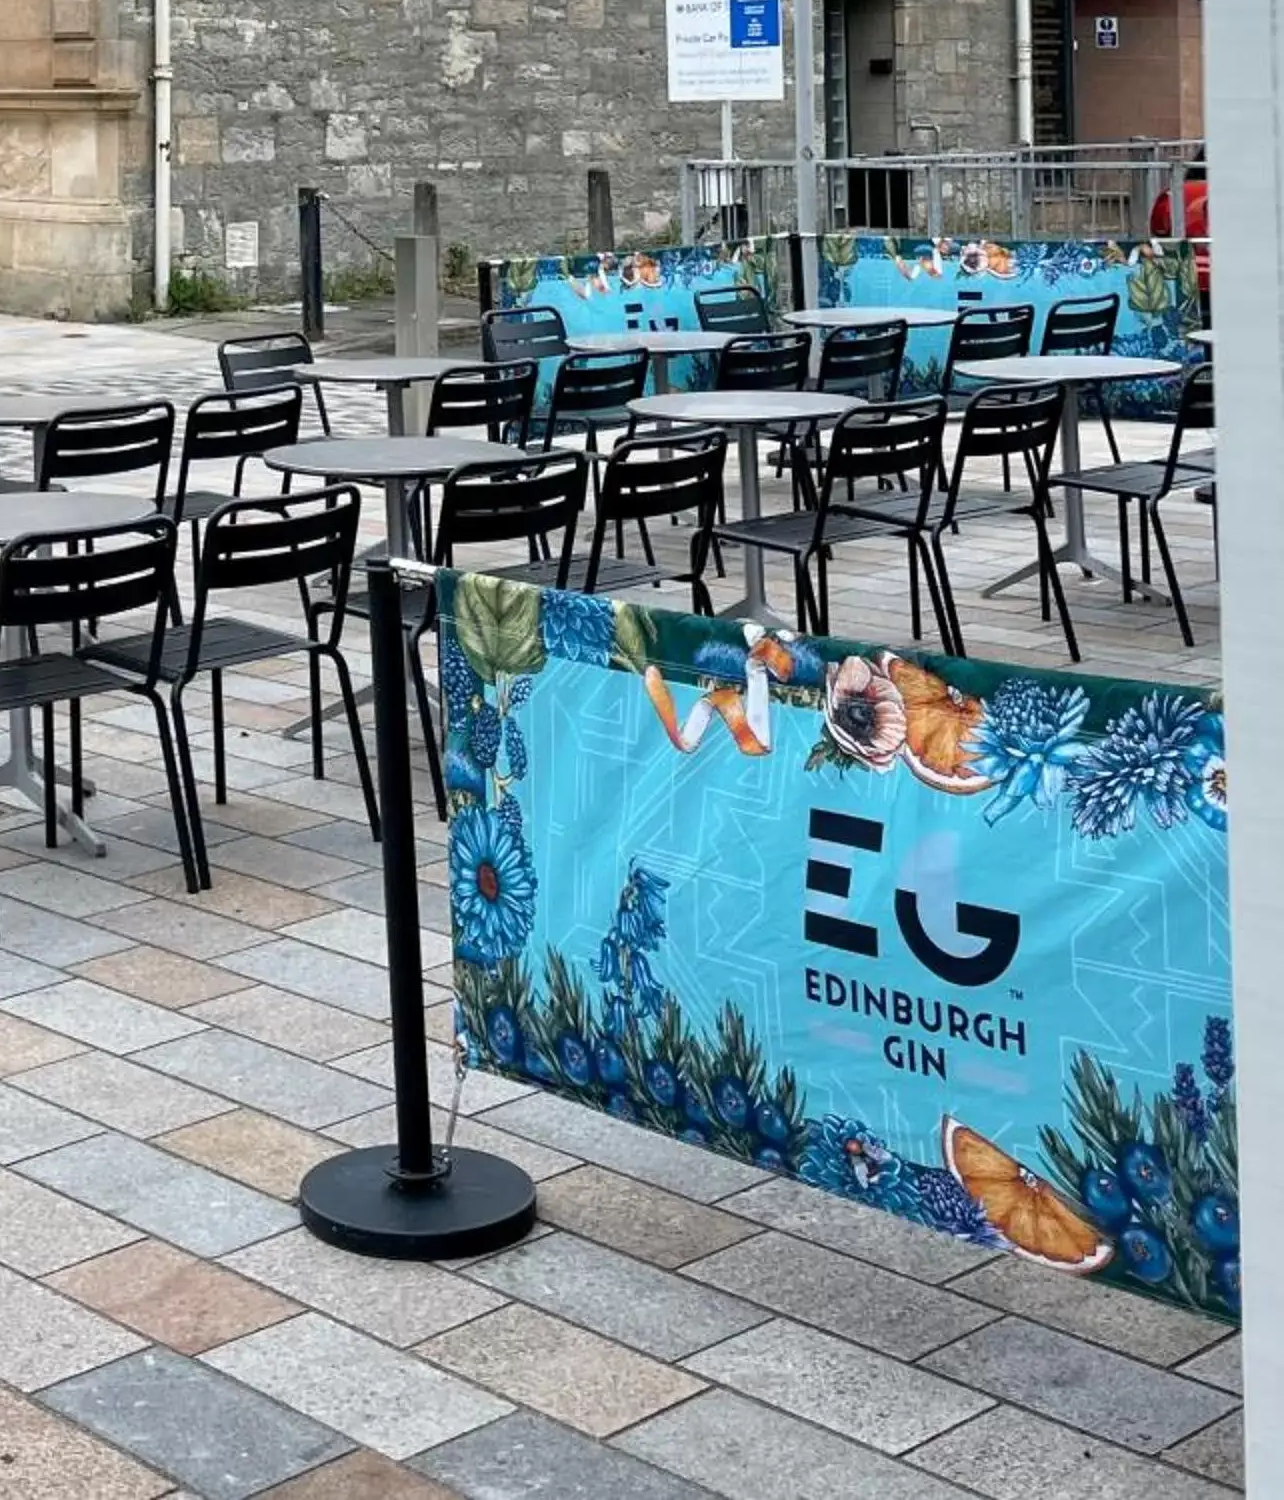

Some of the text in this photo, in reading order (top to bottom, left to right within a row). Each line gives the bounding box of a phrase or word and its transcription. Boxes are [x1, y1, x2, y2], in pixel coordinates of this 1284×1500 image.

[685, 3, 708, 14] BANK
[804, 808, 1020, 986] EG
[804, 967, 1027, 1056] EDINBURGH
[882, 1036, 947, 1080] GIN
